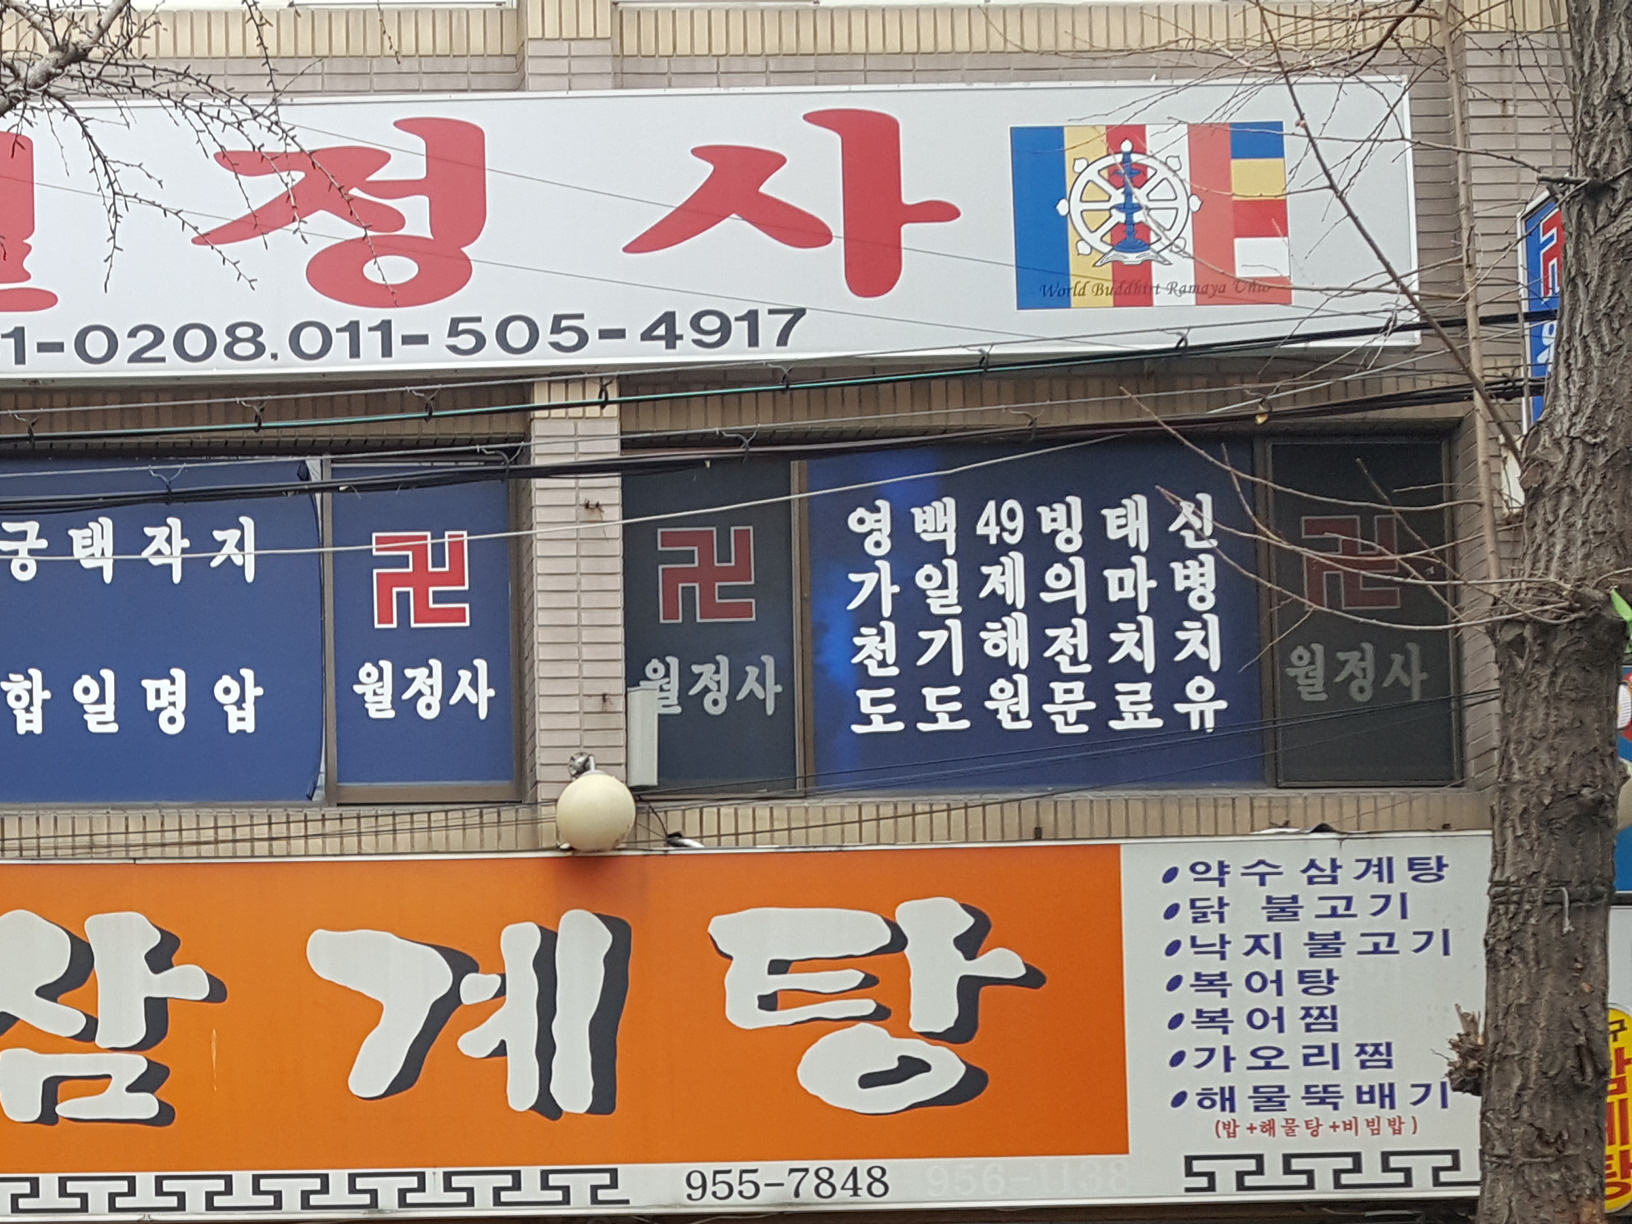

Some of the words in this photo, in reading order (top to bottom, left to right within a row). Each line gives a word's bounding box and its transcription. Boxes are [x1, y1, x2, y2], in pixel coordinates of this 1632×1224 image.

[1041, 280, 1086, 297] World
[640, 653, 783, 717] 월정사
[1284, 642, 1430, 704] 월정사
[353, 658, 496, 721] 월정사
[1189, 896, 1230, 924] 닭
[1261, 892, 1409, 922] 불고기
[1190, 968, 1340, 999] 복어탕
[1191, 1005, 1341, 1035] 복어찜
[1193, 1041, 1395, 1073] 가오리찜
[1196, 1081, 1450, 1114] 해물뚝배기
[685, 1165, 891, 1202] 955-7848
